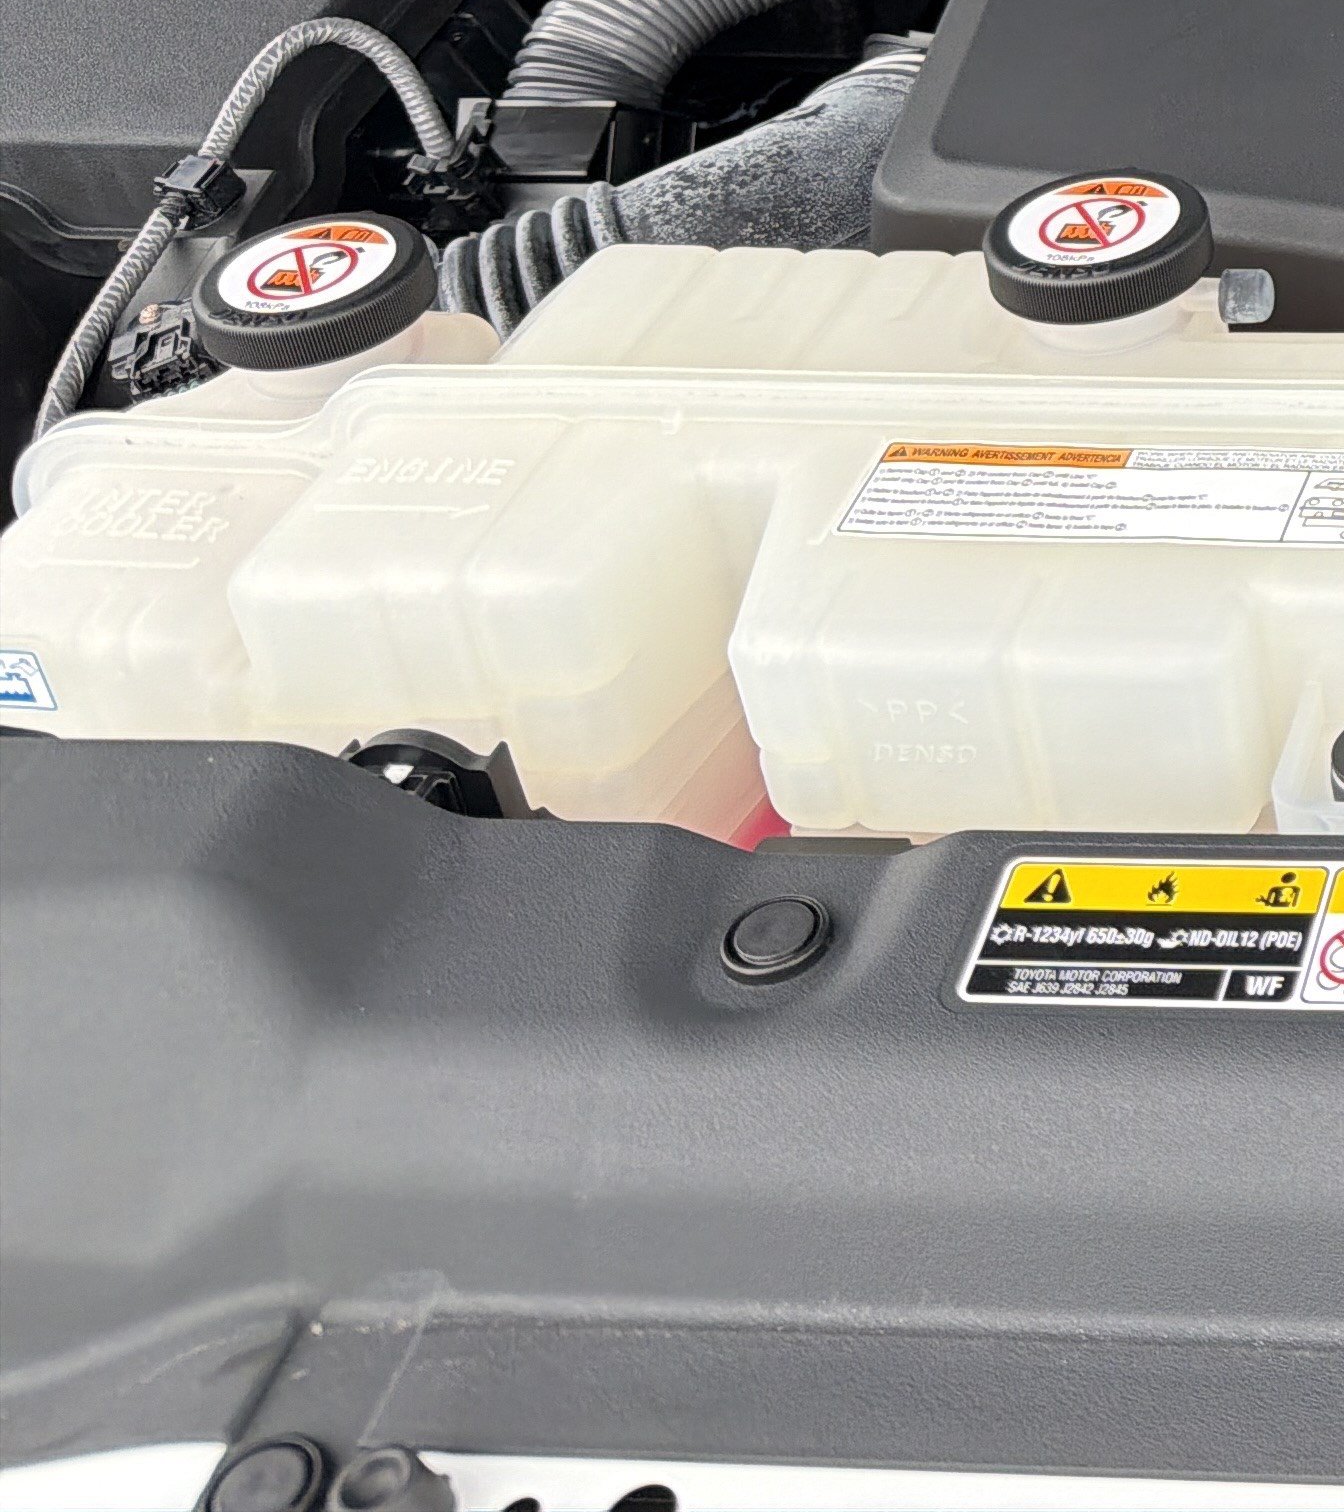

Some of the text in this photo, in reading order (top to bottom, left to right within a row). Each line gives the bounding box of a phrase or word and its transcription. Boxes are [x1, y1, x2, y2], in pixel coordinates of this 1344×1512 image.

[911, 447, 969, 458] WARNING
[971, 449, 1056, 461] AVERTISSEMENT
[1058, 452, 1122, 463] ADVERTENCIA
[336, 456, 516, 485] ENGINE
[78, 488, 217, 516] INTER
[56, 511, 230, 544] COOLER
[872, 743, 977, 763] DENSO
[1012, 925, 1086, 947] R-1234yf
[1086, 927, 1155, 949] 650±30g
[1259, 929, 1303, 952] (POE)
[1014, 968, 1183, 984] TOYOTA MOTOR CORPORATION
[1245, 975, 1285, 996] WF
[1007, 981, 1129, 996] SAE J639 J2842 J2845
